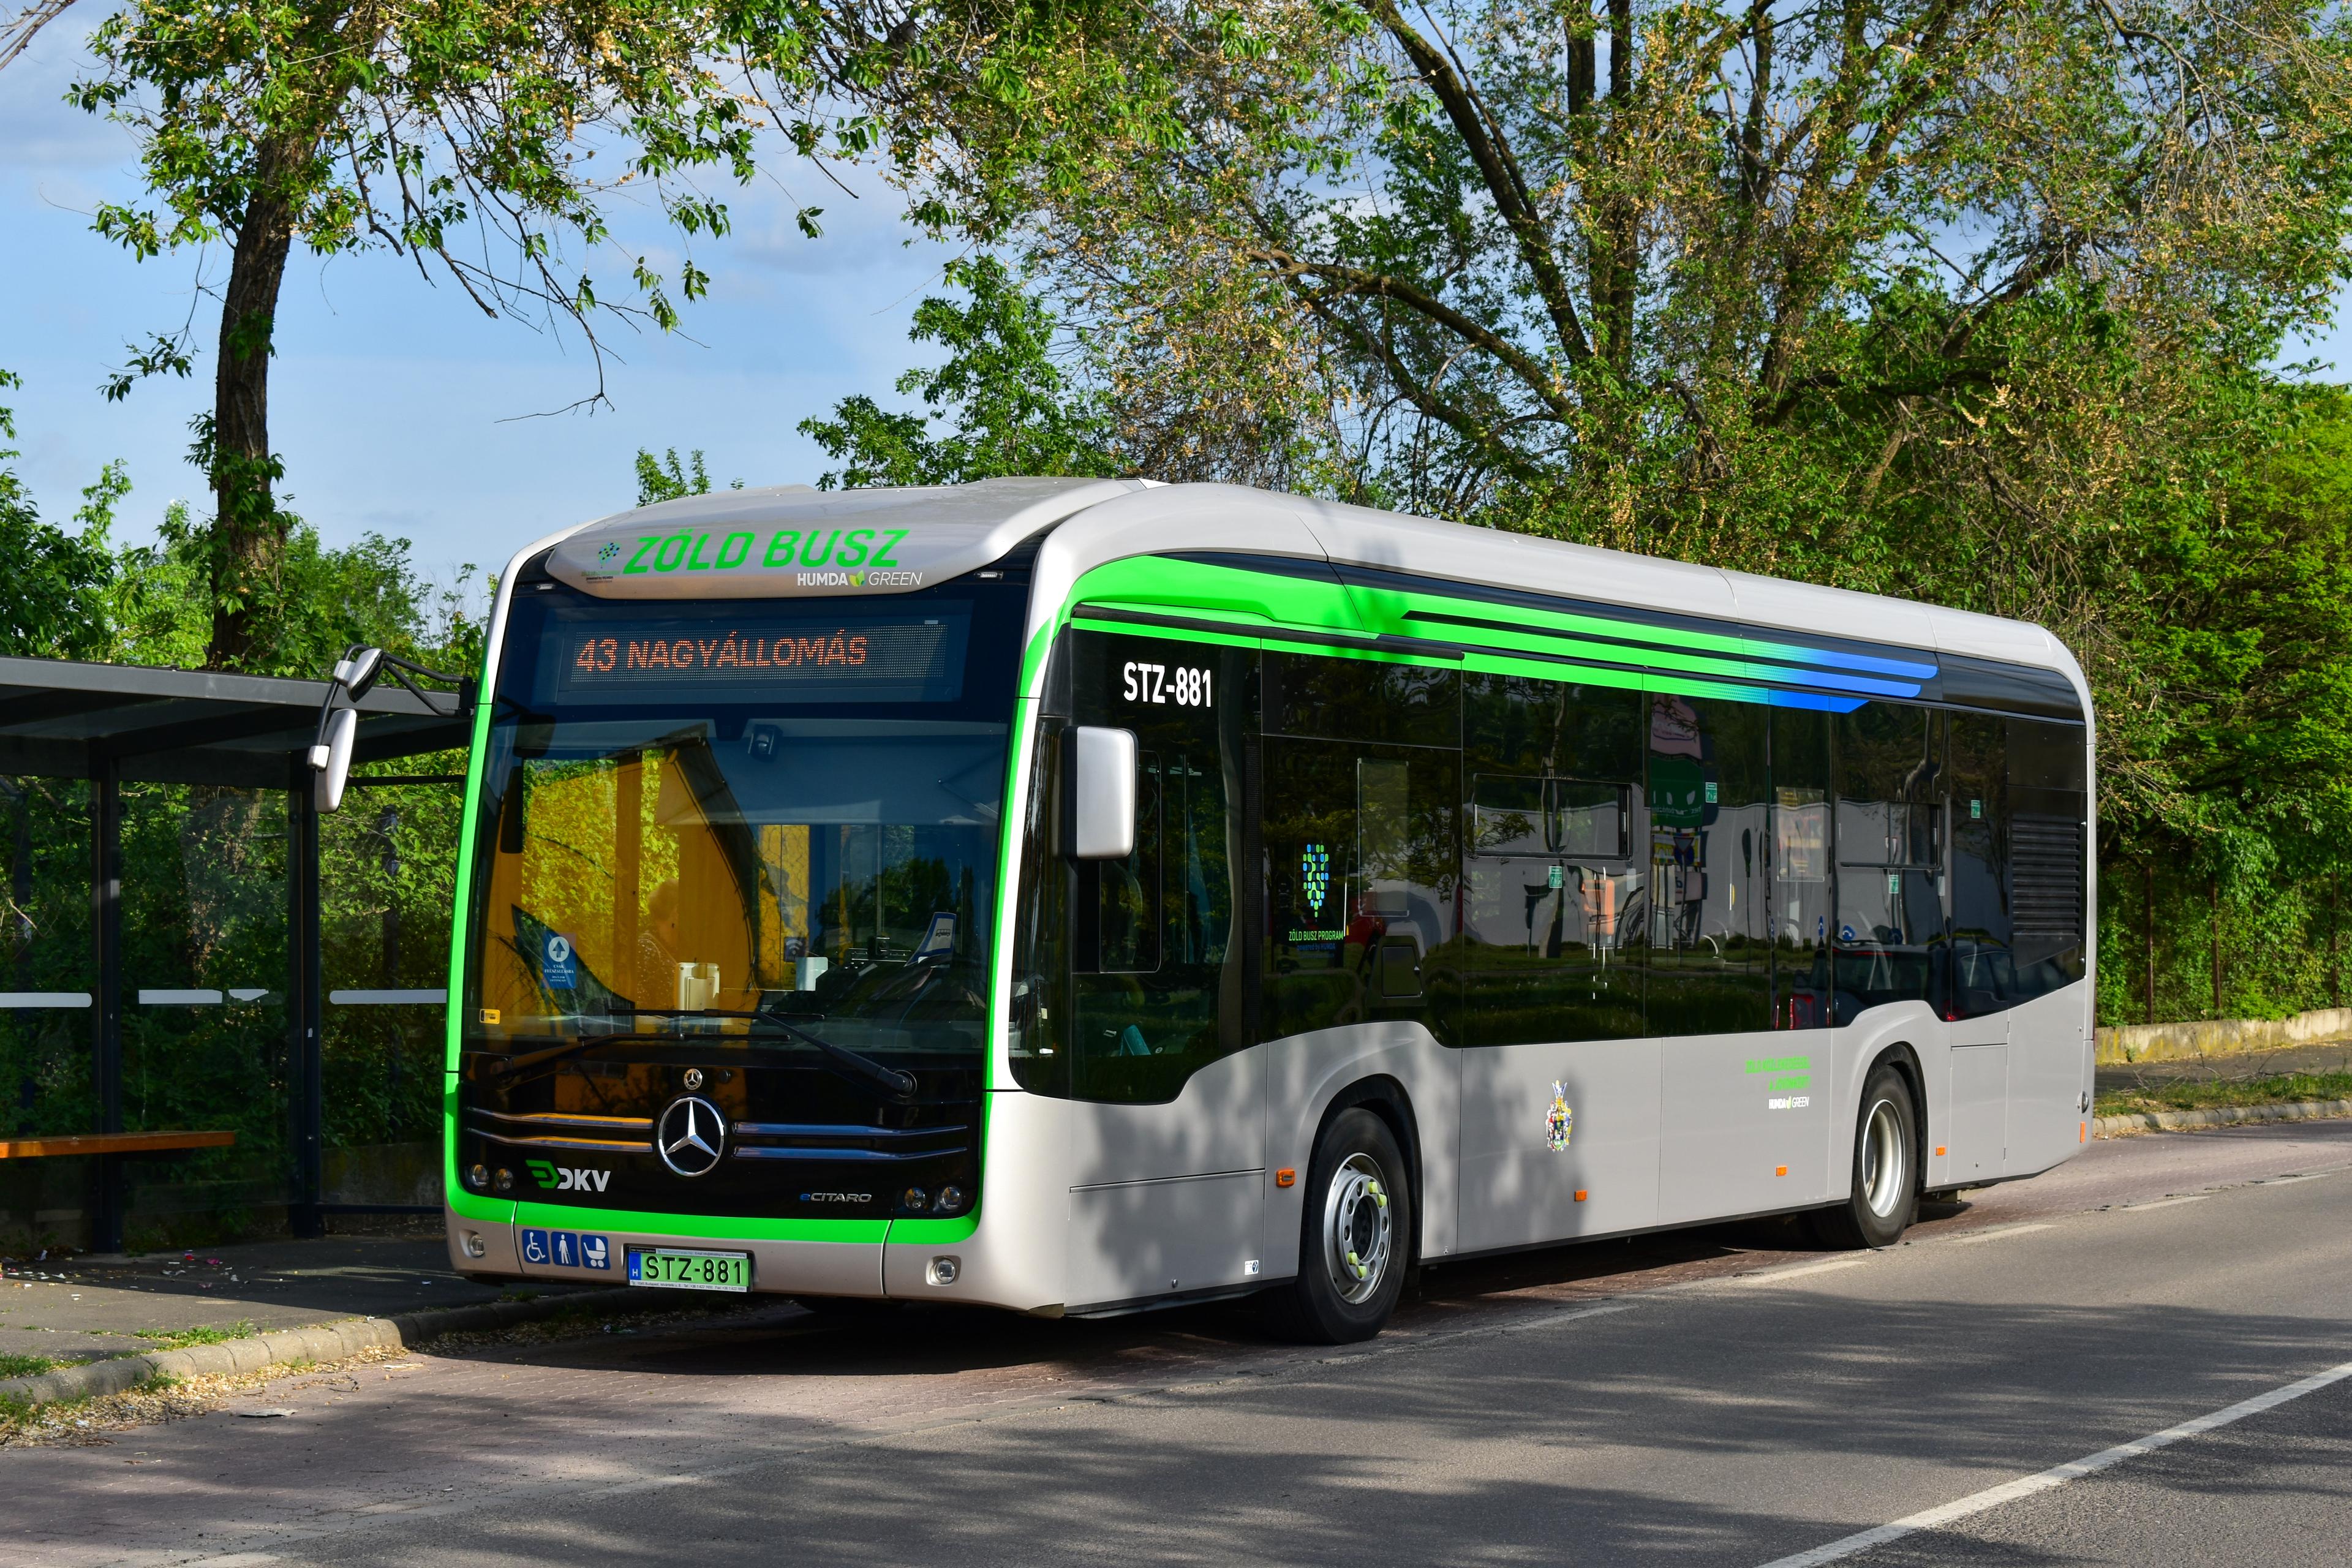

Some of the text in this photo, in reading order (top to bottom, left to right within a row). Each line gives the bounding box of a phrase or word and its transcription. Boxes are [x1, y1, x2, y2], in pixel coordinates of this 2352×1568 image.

[622, 529, 910, 574] ZÖLD BUSZ
[797, 571, 922, 586] HUMDA GREEN
[576, 630, 868, 671] 43 NAGYÁLLOMÁS
[1123, 662, 1211, 707] STZ-881
[1289, 929, 1344, 941] ZÖLD BUSZ PROGRAM
[1792, 1096, 1809, 1107] GREEN
[557, 1167, 611, 1192] DKV
[800, 1193, 872, 1202] eCITARO
[632, 1268, 638, 1277] H
[646, 1256, 742, 1284] STZ-881
